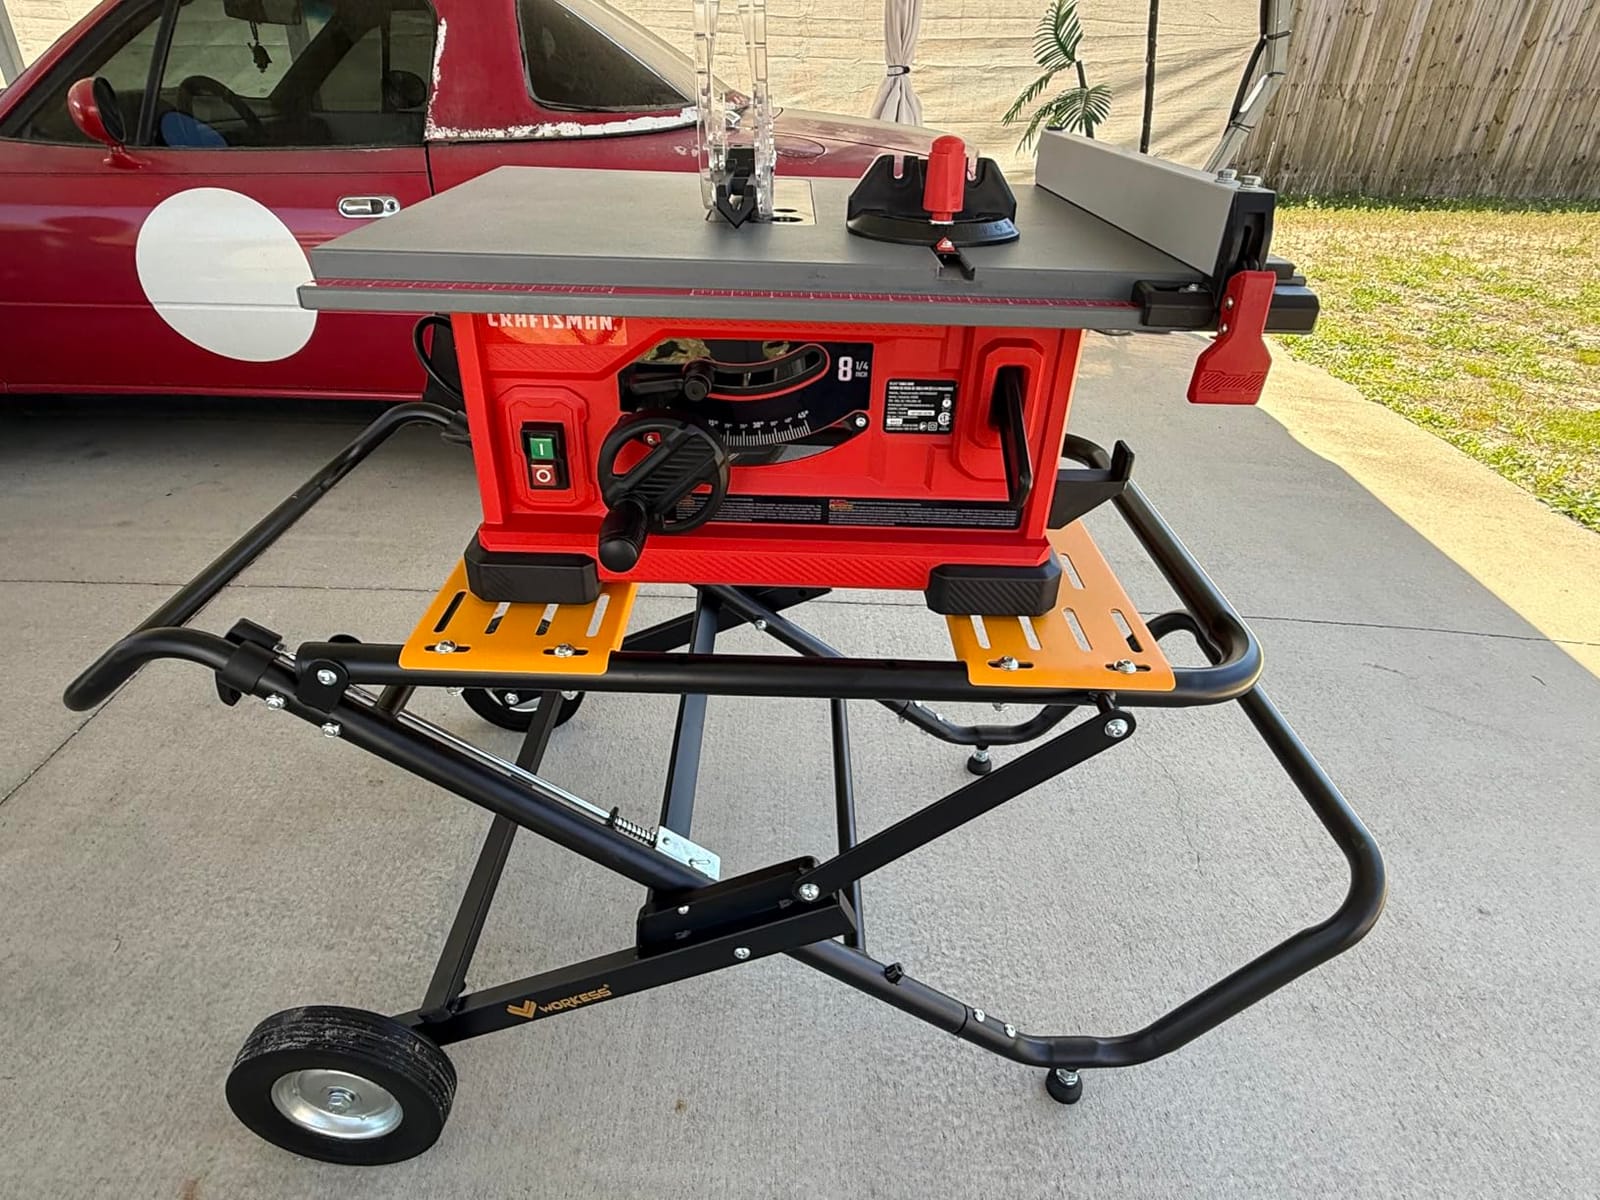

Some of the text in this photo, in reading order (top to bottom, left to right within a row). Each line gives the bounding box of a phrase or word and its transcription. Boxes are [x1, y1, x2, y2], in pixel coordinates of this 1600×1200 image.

[487, 313, 613, 331] CRAFTSMAN
[838, 356, 853, 382] 8
[538, 987, 613, 1014] WORKESS
